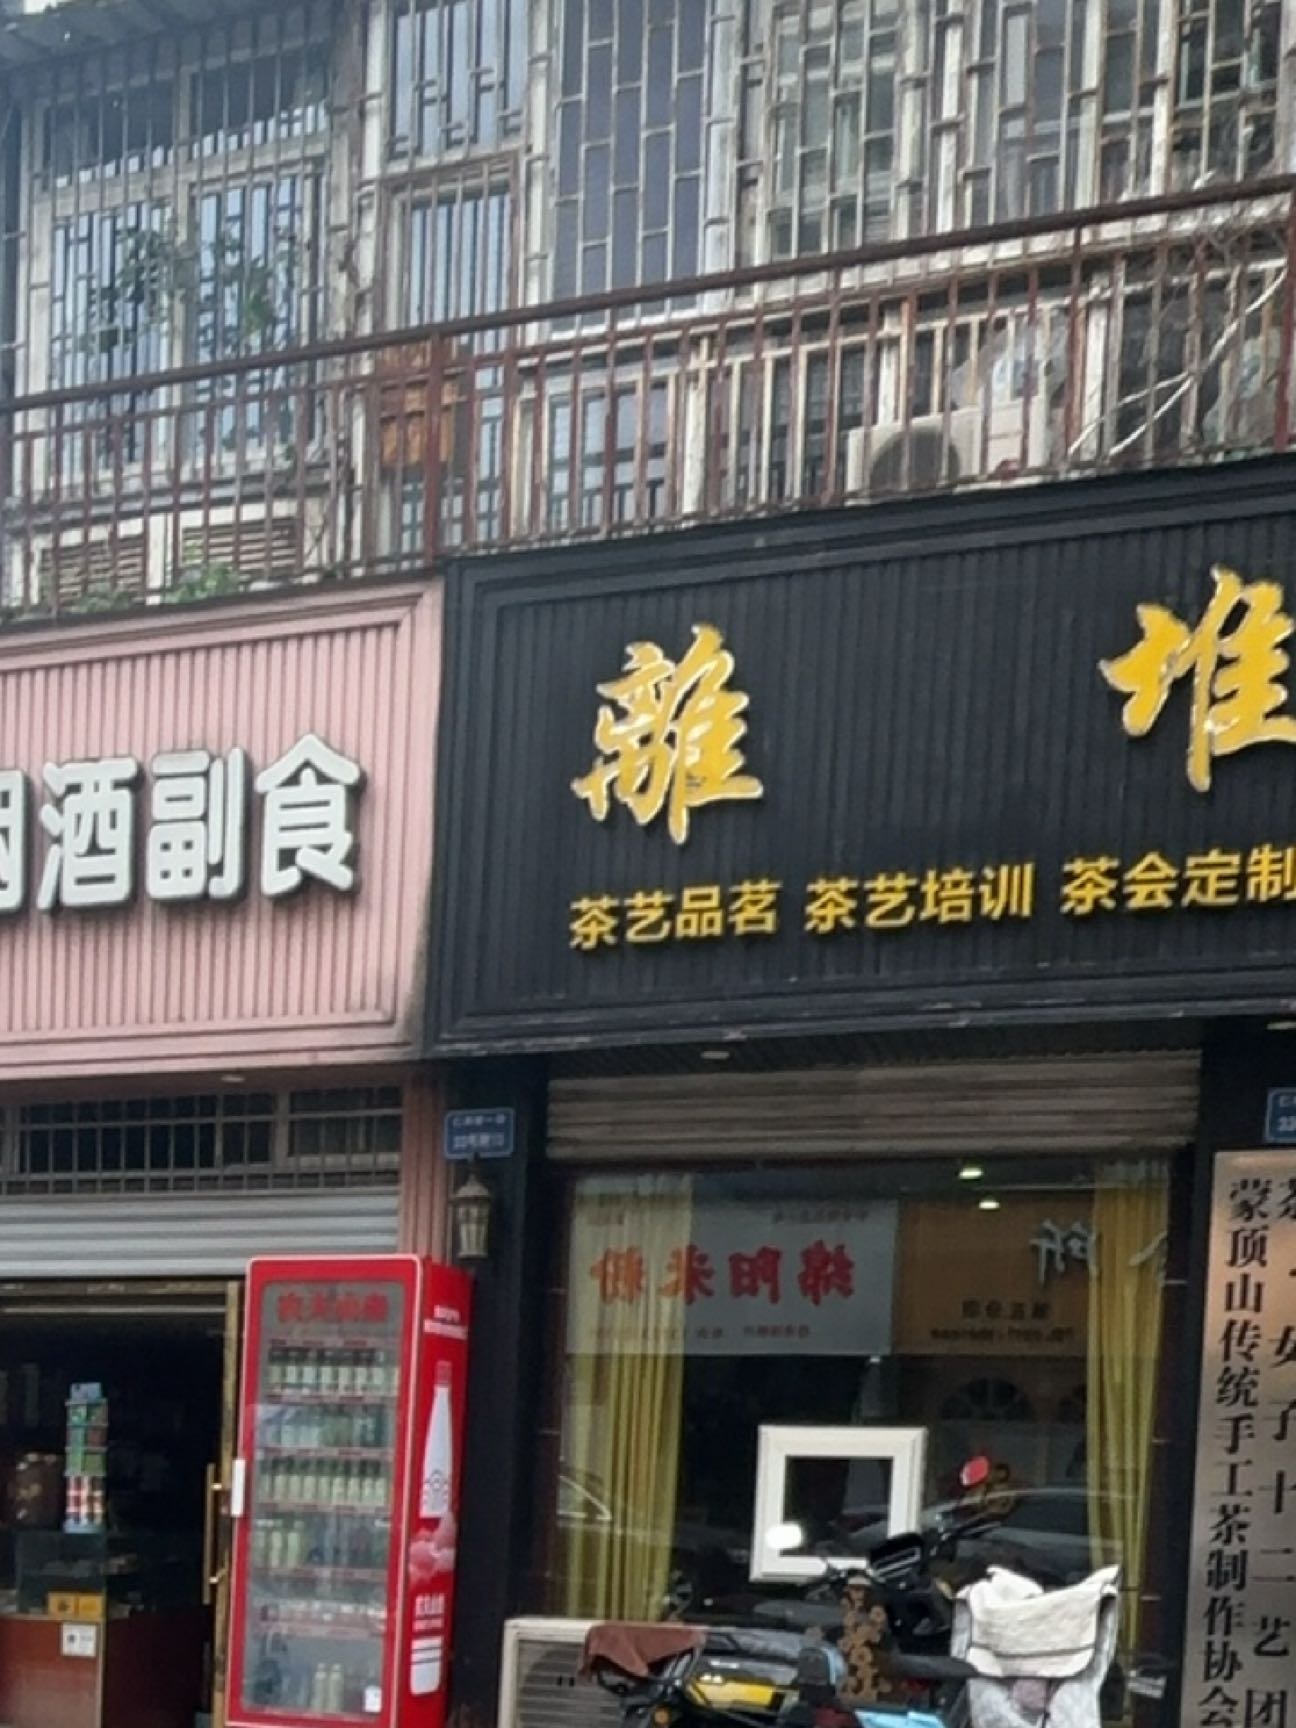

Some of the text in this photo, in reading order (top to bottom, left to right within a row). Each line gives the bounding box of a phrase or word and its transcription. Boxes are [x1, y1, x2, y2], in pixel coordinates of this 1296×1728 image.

[1098, 563, 1296, 791] 堆
[569, 843, 1296, 951] 茶艺品茗 茶艺培训 茶会定制
[1199, 1178, 1272, 1728] 蒙顶山传统手工茶制作协会
